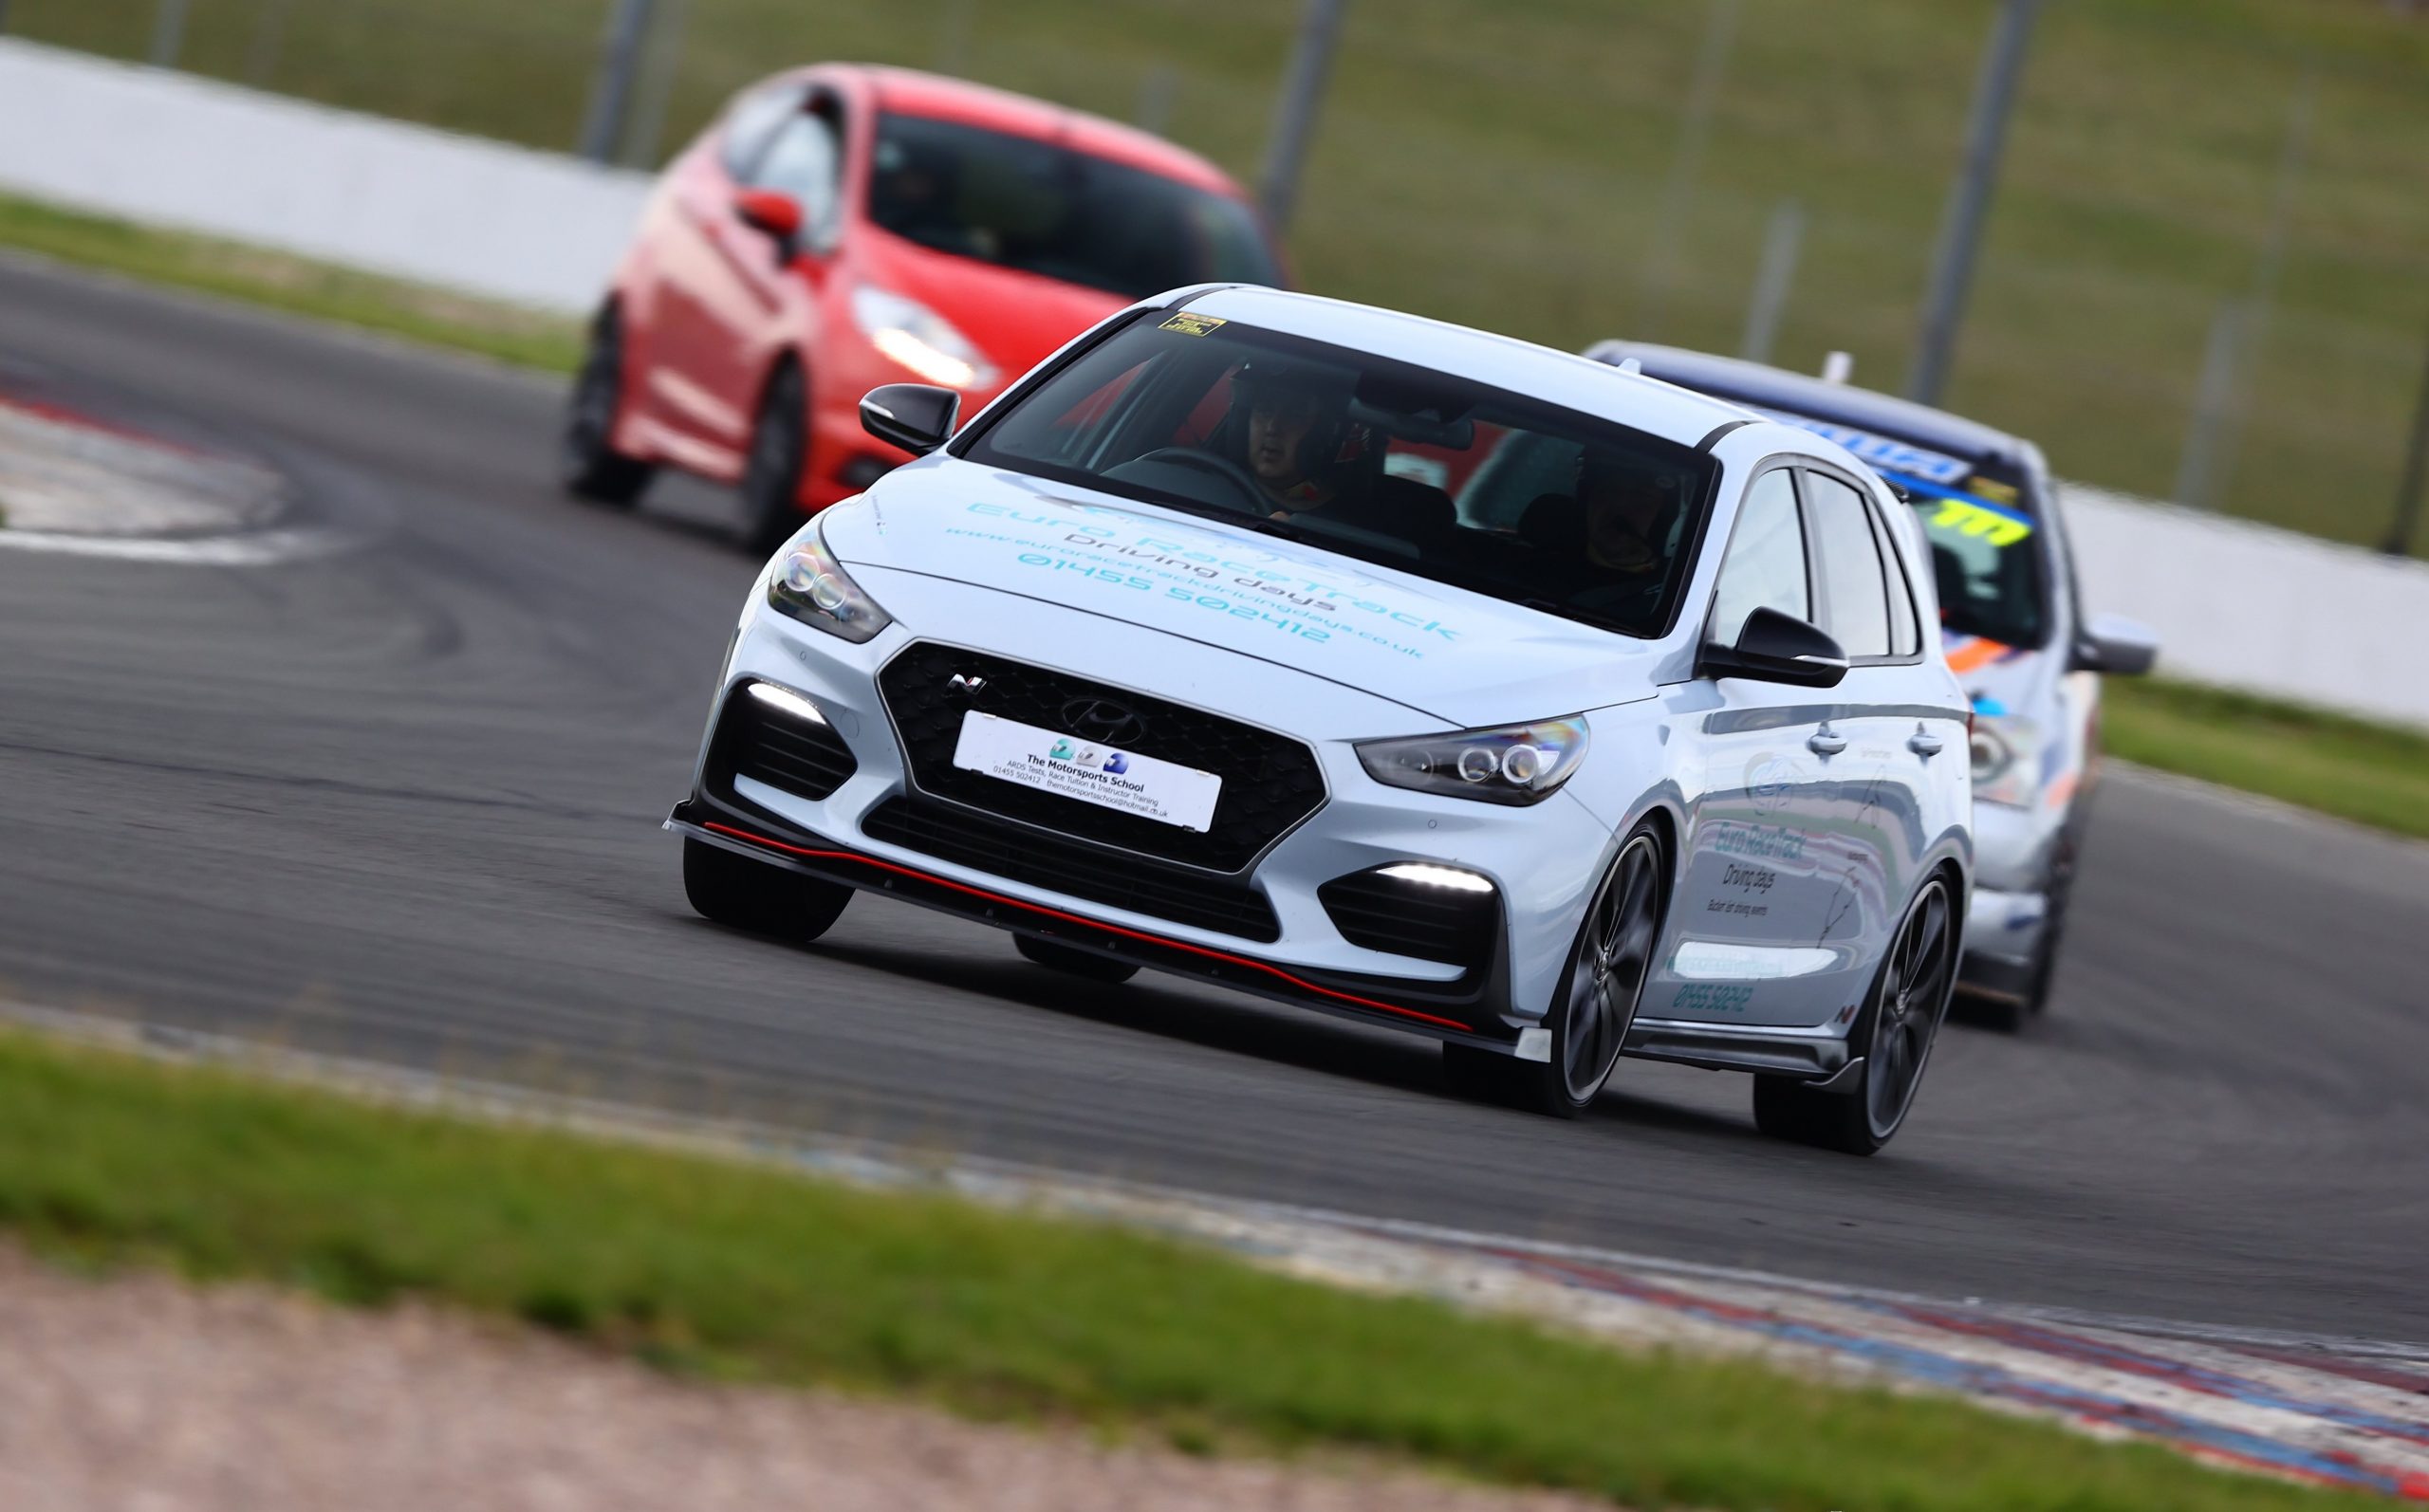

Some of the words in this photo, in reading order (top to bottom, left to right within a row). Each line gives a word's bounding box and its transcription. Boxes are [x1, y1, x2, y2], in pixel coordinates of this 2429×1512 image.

[966, 503, 1116, 538] Euro
[946, 528, 1425, 660] www.euroracetrackdrivingdays.co.uk
[1064, 533, 1218, 580] Driving
[1233, 576, 1337, 612] days
[1017, 553, 1155, 591] 01455
[1164, 586, 1331, 645] 502412
[992, 765, 1014, 777] 01455
[1016, 771, 1041, 784] 502412
[1007, 760, 1026, 771] ARDS
[1029, 765, 1047, 778] Tests,
[1048, 771, 1066, 782] Race
[1066, 776, 1089, 788] Tuition
[1098, 784, 1131, 798] Instructor
[1133, 793, 1159, 807] Training
[1028, 754, 1046, 766] The
[1048, 760, 1108, 784] Motorsports
[1110, 776, 1145, 793] School
